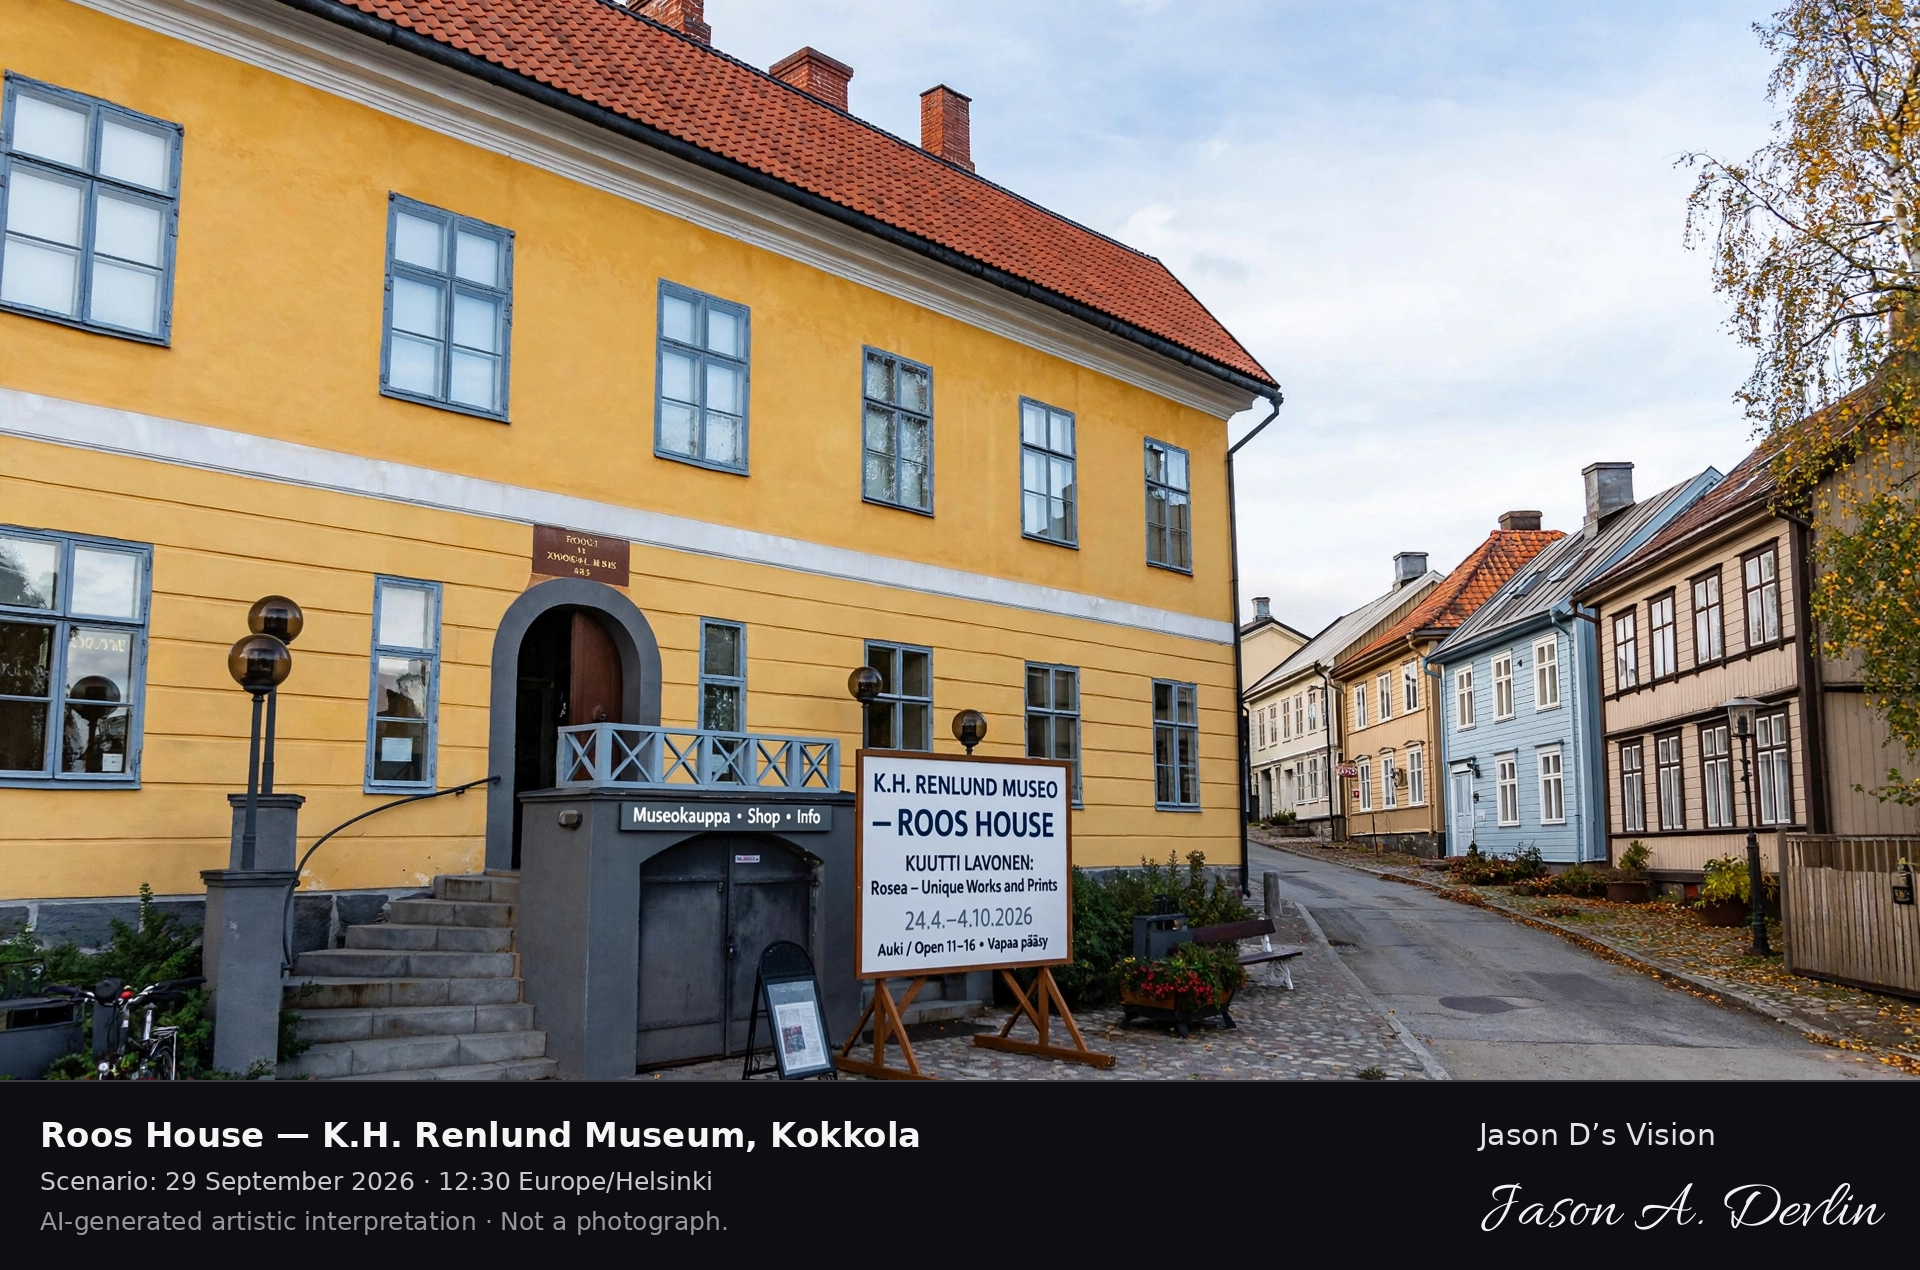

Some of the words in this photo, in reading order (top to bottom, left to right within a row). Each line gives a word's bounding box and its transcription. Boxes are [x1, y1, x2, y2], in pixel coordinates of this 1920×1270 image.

[873, 772, 911, 794] K.H.
[915, 774, 998, 796] RENLUND
[1002, 778, 1058, 799] MUSEO
[633, 806, 731, 828] Museokauppa
[747, 807, 781, 829] Shop
[797, 808, 821, 825] Info
[898, 808, 969, 837] ROOS
[976, 810, 1055, 838] HOUSE
[905, 854, 960, 872] KUUTTI
[964, 854, 1034, 871] LAVONEN:
[871, 880, 908, 896] Rosea
[921, 879, 964, 898] Unique
[966, 878, 1002, 894] Works
[1004, 878, 1025, 893] and
[1027, 878, 1058, 892] Prints
[877, 941, 904, 957] Auki
[915, 940, 944, 957] Open
[987, 937, 1019, 953] Vapaa
[1021, 934, 1049, 952] pääsy
